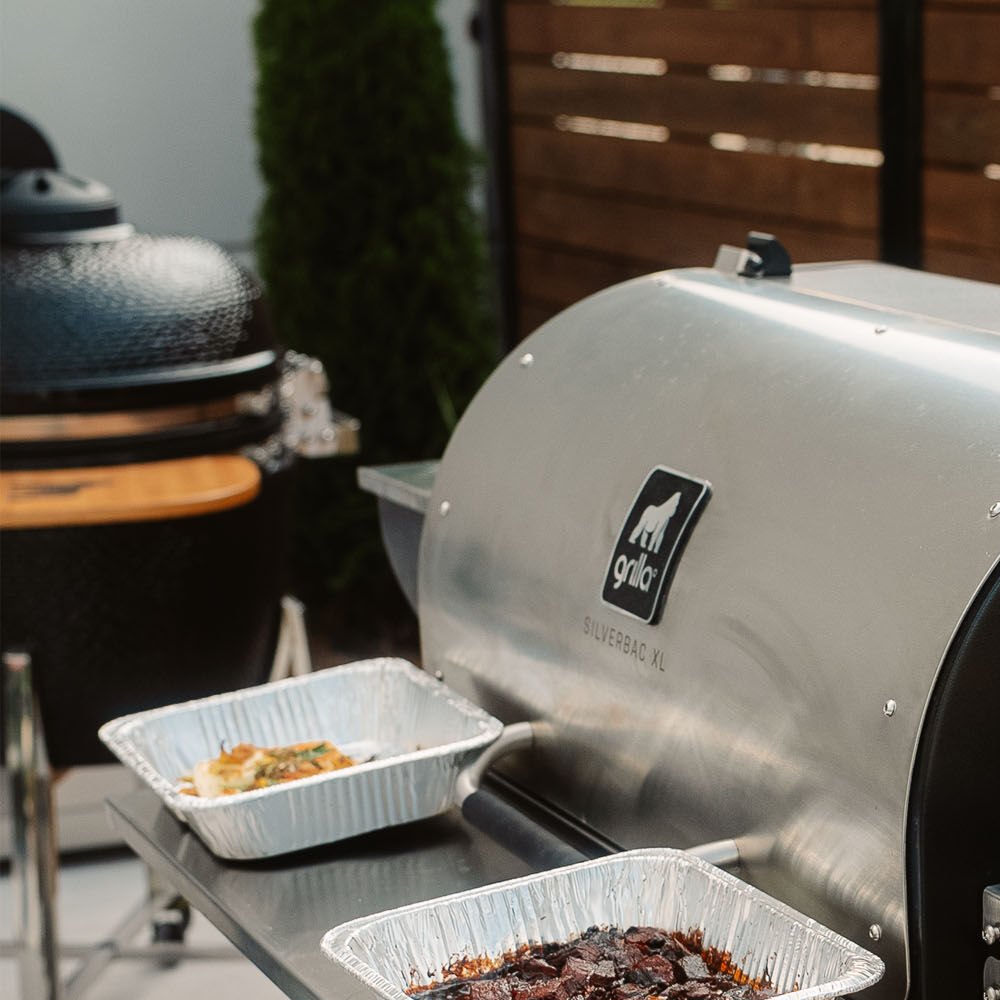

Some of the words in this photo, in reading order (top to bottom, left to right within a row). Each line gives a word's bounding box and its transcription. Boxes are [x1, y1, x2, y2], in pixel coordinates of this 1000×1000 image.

[613, 552, 653, 592] grilla
[583, 616, 646, 662] SILVERBAC
[651, 648, 666, 673] XL
